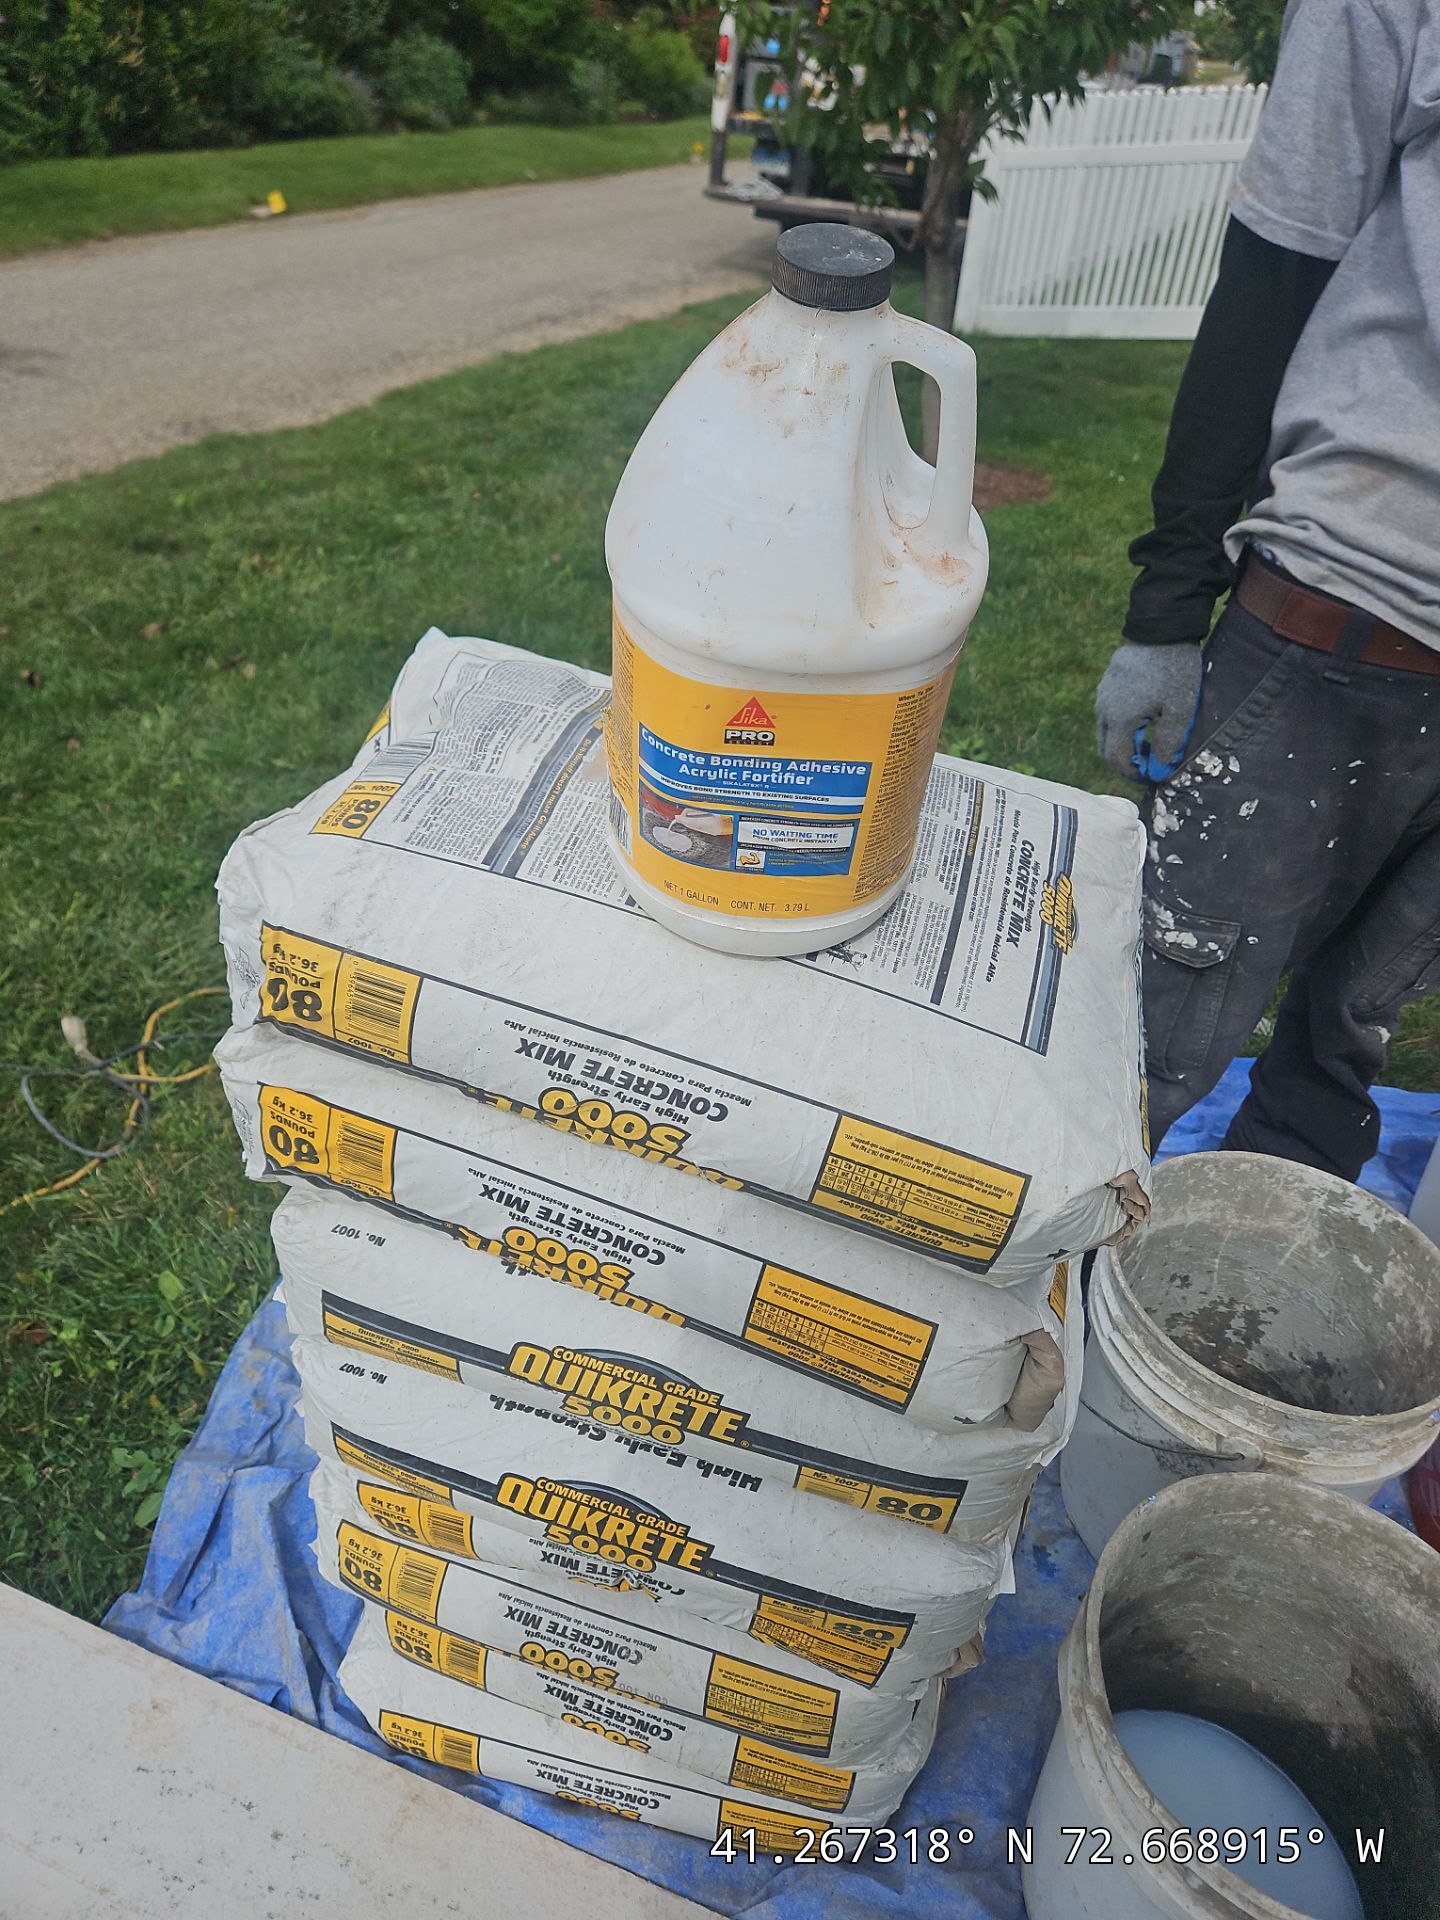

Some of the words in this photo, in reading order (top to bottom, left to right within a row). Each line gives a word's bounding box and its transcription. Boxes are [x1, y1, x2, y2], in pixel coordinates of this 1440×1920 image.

[733, 706, 769, 725] Sika
[726, 729, 774, 741] PRO
[641, 728, 705, 766] Concrete
[710, 756, 782, 773] Bonding
[787, 760, 866, 776] Adhesive
[678, 763, 737, 781] Acrylic
[742, 769, 814, 786] Fortifier
[660, 776, 693, 792] IMPROVES
[714, 788, 751, 796] STRENGTH
[794, 795, 830, 803] SURFACES
[342, 798, 382, 828] 80
[752, 828, 768, 837] NO
[770, 829, 813, 839] WAITING
[816, 832, 839, 840] TIME
[1005, 844, 1016, 875] Concreto
[1012, 839, 1034, 909] CONCRETE
[663, 879, 678, 894] NET
[686, 888, 719, 906] GALLON
[731, 899, 756, 912] CONT.
[759, 903, 777, 912] NET.
[784, 903, 803, 912] 3.79
[1028, 876, 1038, 897] Early
[995, 886, 1010, 932] Resistencia
[1038, 881, 1056, 925] 5000
[1053, 872, 1072, 951] QUIKRETE
[1024, 898, 1035, 932] Strength
[1005, 911, 1024, 947] MIX
[989, 933, 1002, 960] Inicial
[286, 953, 318, 972] 36.2
[984, 962, 996, 983] Alta
[267, 960, 321, 991] POUNDS
[269, 977, 322, 1024] 80
[503, 1018, 526, 1032] Alta
[527, 1026, 560, 1043] Inicial
[346, 1036, 373, 1050] 1007
[512, 1035, 575, 1071] MIX
[562, 1036, 620, 1062] Resistencia
[622, 1056, 636, 1068] de
[638, 1062, 684, 1084] Concreto
[546, 1068, 610, 1098] Strength
[579, 1057, 730, 1124] CONCRETE
[686, 1077, 712, 1093] Para
[271, 1095, 285, 1110] kg
[613, 1090, 651, 1111] Early
[713, 1087, 751, 1107] Mezcla
[268, 1110, 315, 1139] POUNDS
[287, 1105, 313, 1123] 36.2
[536, 1083, 689, 1157] 5000
[653, 1104, 690, 1125] High
[268, 1123, 318, 1162] 80
[466, 1166, 487, 1179] Alta
[487, 1174, 516, 1190] Inicial
[477, 1183, 530, 1214] MIX
[517, 1185, 569, 1210] Resistencia
[570, 1204, 583, 1215] de
[583, 1210, 626, 1231] Concreto
[836, 1197, 893, 1223] Calculator
[330, 1222, 361, 1240] 1007
[506, 1210, 563, 1238] Strength
[627, 1226, 650, 1240] Para
[363, 1232, 386, 1247] No.
[533, 1204, 667, 1267] CONCRETE
[564, 1231, 599, 1251] Early
[650, 1235, 685, 1254] Mezcla
[918, 1226, 970, 1250] Concrete
[499, 1223, 632, 1290] 5000
[600, 1245, 633, 1265] High
[338, 1361, 366, 1377] 1007
[367, 1370, 387, 1385] No.
[550, 1345, 659, 1389] COMMERCIAL
[662, 1378, 720, 1407] GRADE
[506, 1342, 745, 1445] QUIKRETE
[562, 1394, 685, 1447] 5000
[833, 1476, 860, 1488] 1007
[369, 1495, 384, 1507] kg
[384, 1501, 407, 1513] 36.2
[534, 1477, 633, 1520] COMMERCIAL
[634, 1510, 687, 1538] GRADE
[875, 1495, 942, 1518] 80
[373, 1513, 418, 1539] 80
[493, 1474, 710, 1573] QUIKRETE
[347, 1537, 359, 1551] kg
[361, 1546, 382, 1561] 36.2
[544, 1523, 655, 1573] 5000
[343, 1548, 381, 1572] POUNDS
[538, 1549, 579, 1570] MIX
[345, 1556, 381, 1591] 80
[501, 1604, 543, 1630] MIX
[392, 1627, 429, 1649] POUNDS
[408, 1626, 429, 1639] 36.2
[523, 1627, 566, 1649] Strength
[546, 1619, 644, 1666] CONCRETE
[832, 1622, 894, 1642] 80
[394, 1635, 432, 1663] 80
[566, 1642, 593, 1658] Early
[593, 1652, 618, 1668] High
[517, 1639, 619, 1687] 5000
[542, 1683, 579, 1706] MIX
[561, 1702, 602, 1722] Strength
[581, 1697, 673, 1742] CONCRETE
[389, 1721, 403, 1732] kg
[403, 1727, 423, 1738] 36.2
[602, 1718, 627, 1732] Early
[626, 1727, 650, 1741] High
[386, 1731, 425, 1747] POUNDS
[534, 1768, 569, 1785] MIX
[571, 1779, 658, 1809] CONCRETE
